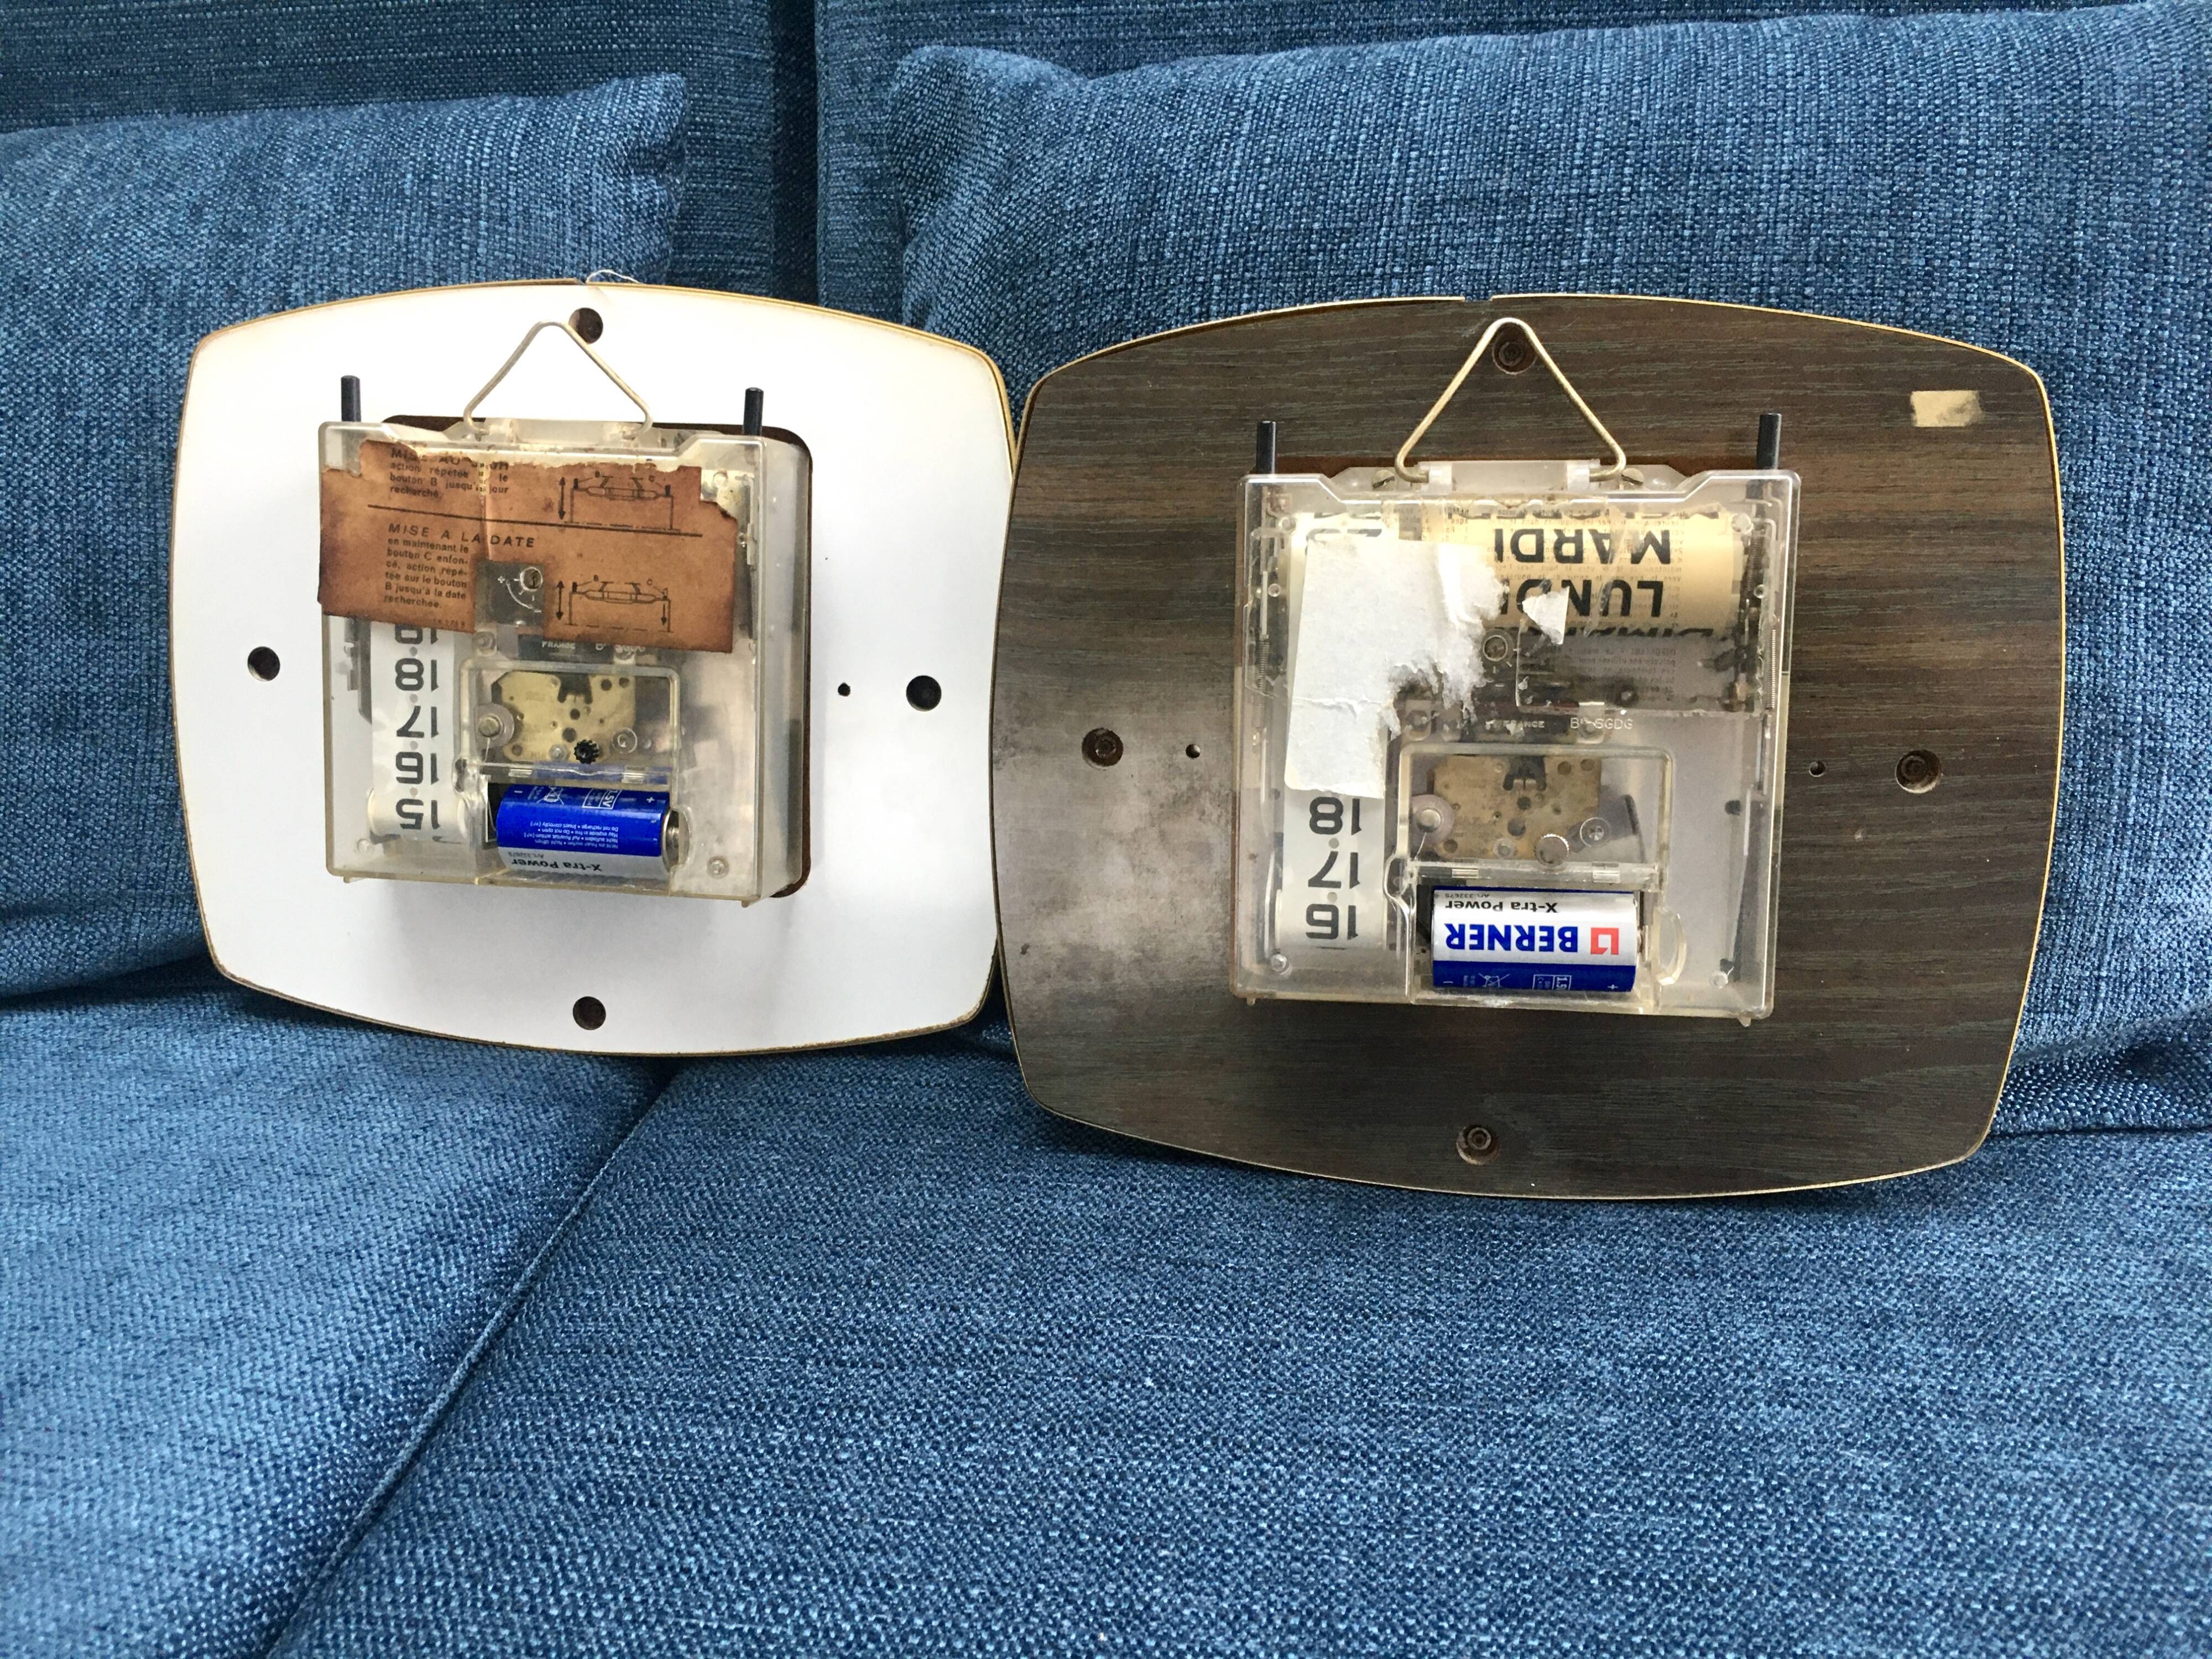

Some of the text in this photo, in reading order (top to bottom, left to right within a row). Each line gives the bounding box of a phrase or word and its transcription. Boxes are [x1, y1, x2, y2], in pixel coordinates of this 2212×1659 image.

[390, 462, 421, 473] action
[499, 473, 508, 482] le
[390, 473, 424, 484] bouton
[430, 477, 437, 487] B
[389, 523, 535, 548] MISE A LA DATE
[387, 547, 468, 565] bouton C enfon-
[403, 540, 457, 552] maintenant
[460, 544, 469, 554] le
[1494, 528, 1671, 565] MARDI
[406, 563, 436, 573] action
[385, 582, 392, 591] B
[435, 588, 443, 597] la
[445, 590, 467, 600] date
[405, 574, 420, 583] sur
[422, 575, 431, 584] le
[434, 576, 467, 589] bouton
[395, 658, 439, 691] 18
[396, 706, 440, 738] 17
[396, 752, 439, 785] 16
[396, 798, 440, 830] 15
[1309, 796, 1362, 836] 18
[512, 858, 603, 872] X-tra Power
[1308, 851, 1361, 889] 17
[1445, 900, 1559, 914] X-tra Power
[1306, 904, 1359, 940] 16
[1444, 923, 1578, 953] BERNER
